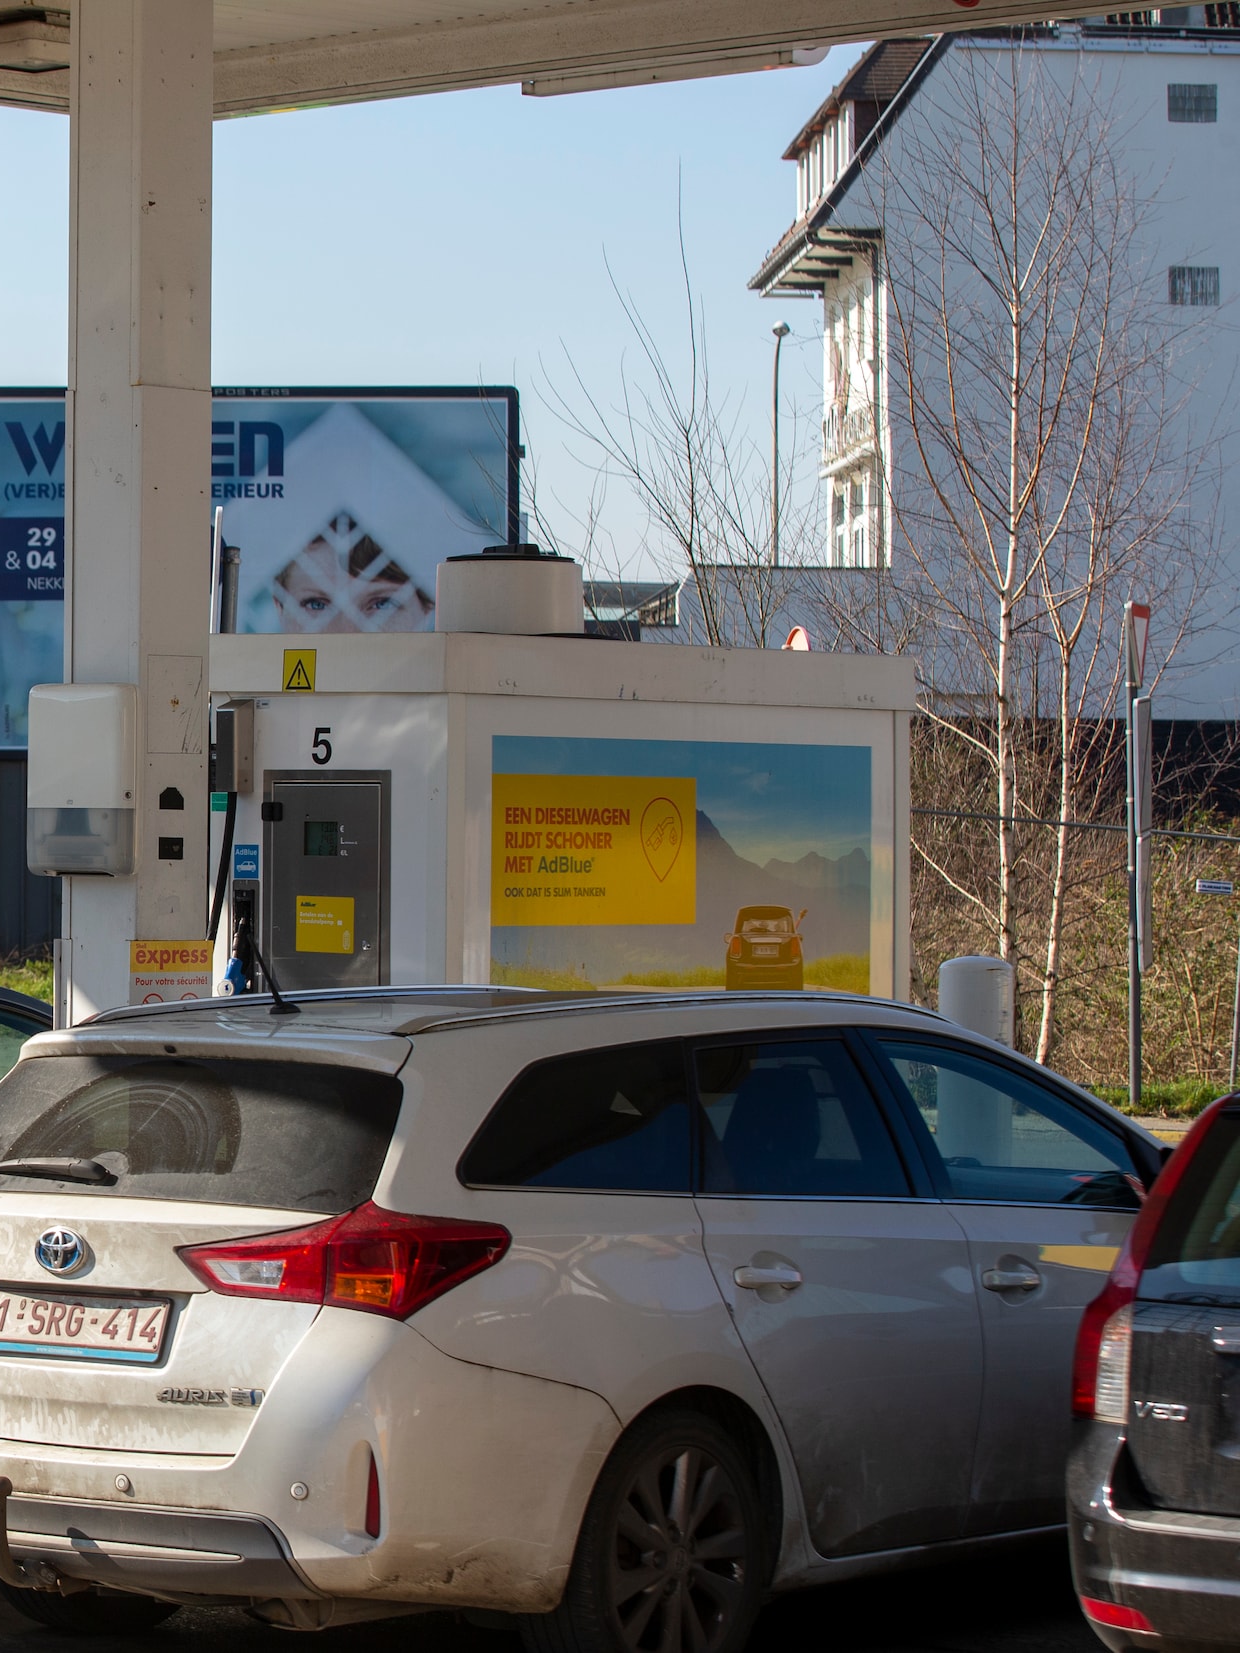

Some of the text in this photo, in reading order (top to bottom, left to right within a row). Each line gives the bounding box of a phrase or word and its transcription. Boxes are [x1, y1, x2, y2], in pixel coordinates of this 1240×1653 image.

[211, 483, 284, 498] ERIEUR
[27, 527, 56, 546] 29
[5, 550, 56, 570] & 04
[27, 577, 64, 590] NEKK
[312, 727, 332, 764] 5
[505, 807, 630, 826] EEN DIESELWAGEN
[505, 832, 613, 849] RIJDT SCHONER
[504, 856, 593, 873] MET AdBlue
[504, 887, 606, 898] OOK DAT IS SLIM TANKEN
[135, 949, 208, 970] express
[135, 977, 153, 986] Pour
[177, 976, 208, 985] sécurité!
[157, 1387, 226, 1403] AURIS
